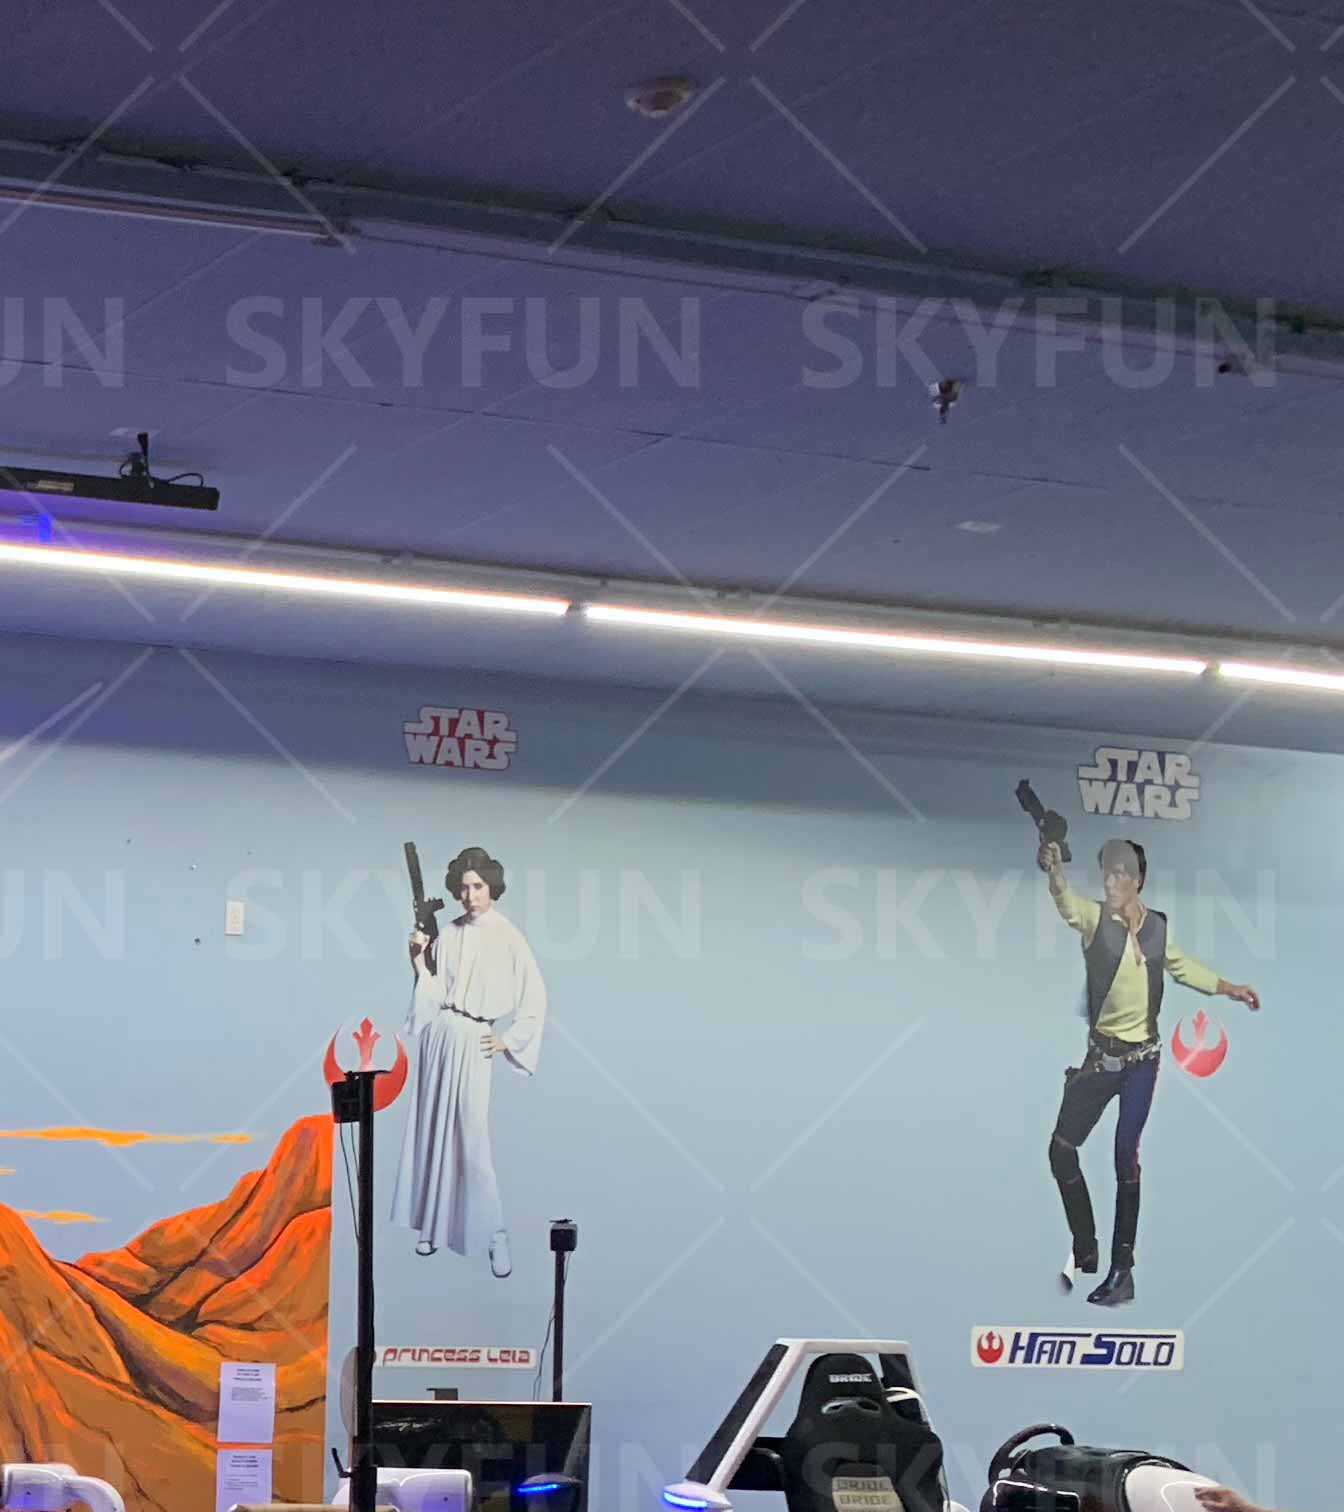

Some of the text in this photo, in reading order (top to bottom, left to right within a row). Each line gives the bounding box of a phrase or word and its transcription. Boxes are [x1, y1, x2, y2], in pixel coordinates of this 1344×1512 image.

[403, 705, 518, 743] STAR
[403, 733, 518, 771] WARS
[1078, 747, 1200, 789] STAR
[1078, 779, 1200, 820] WARS
[1009, 1332, 1176, 1366] HAN SOLO
[829, 1373, 873, 1383] BRIDE
